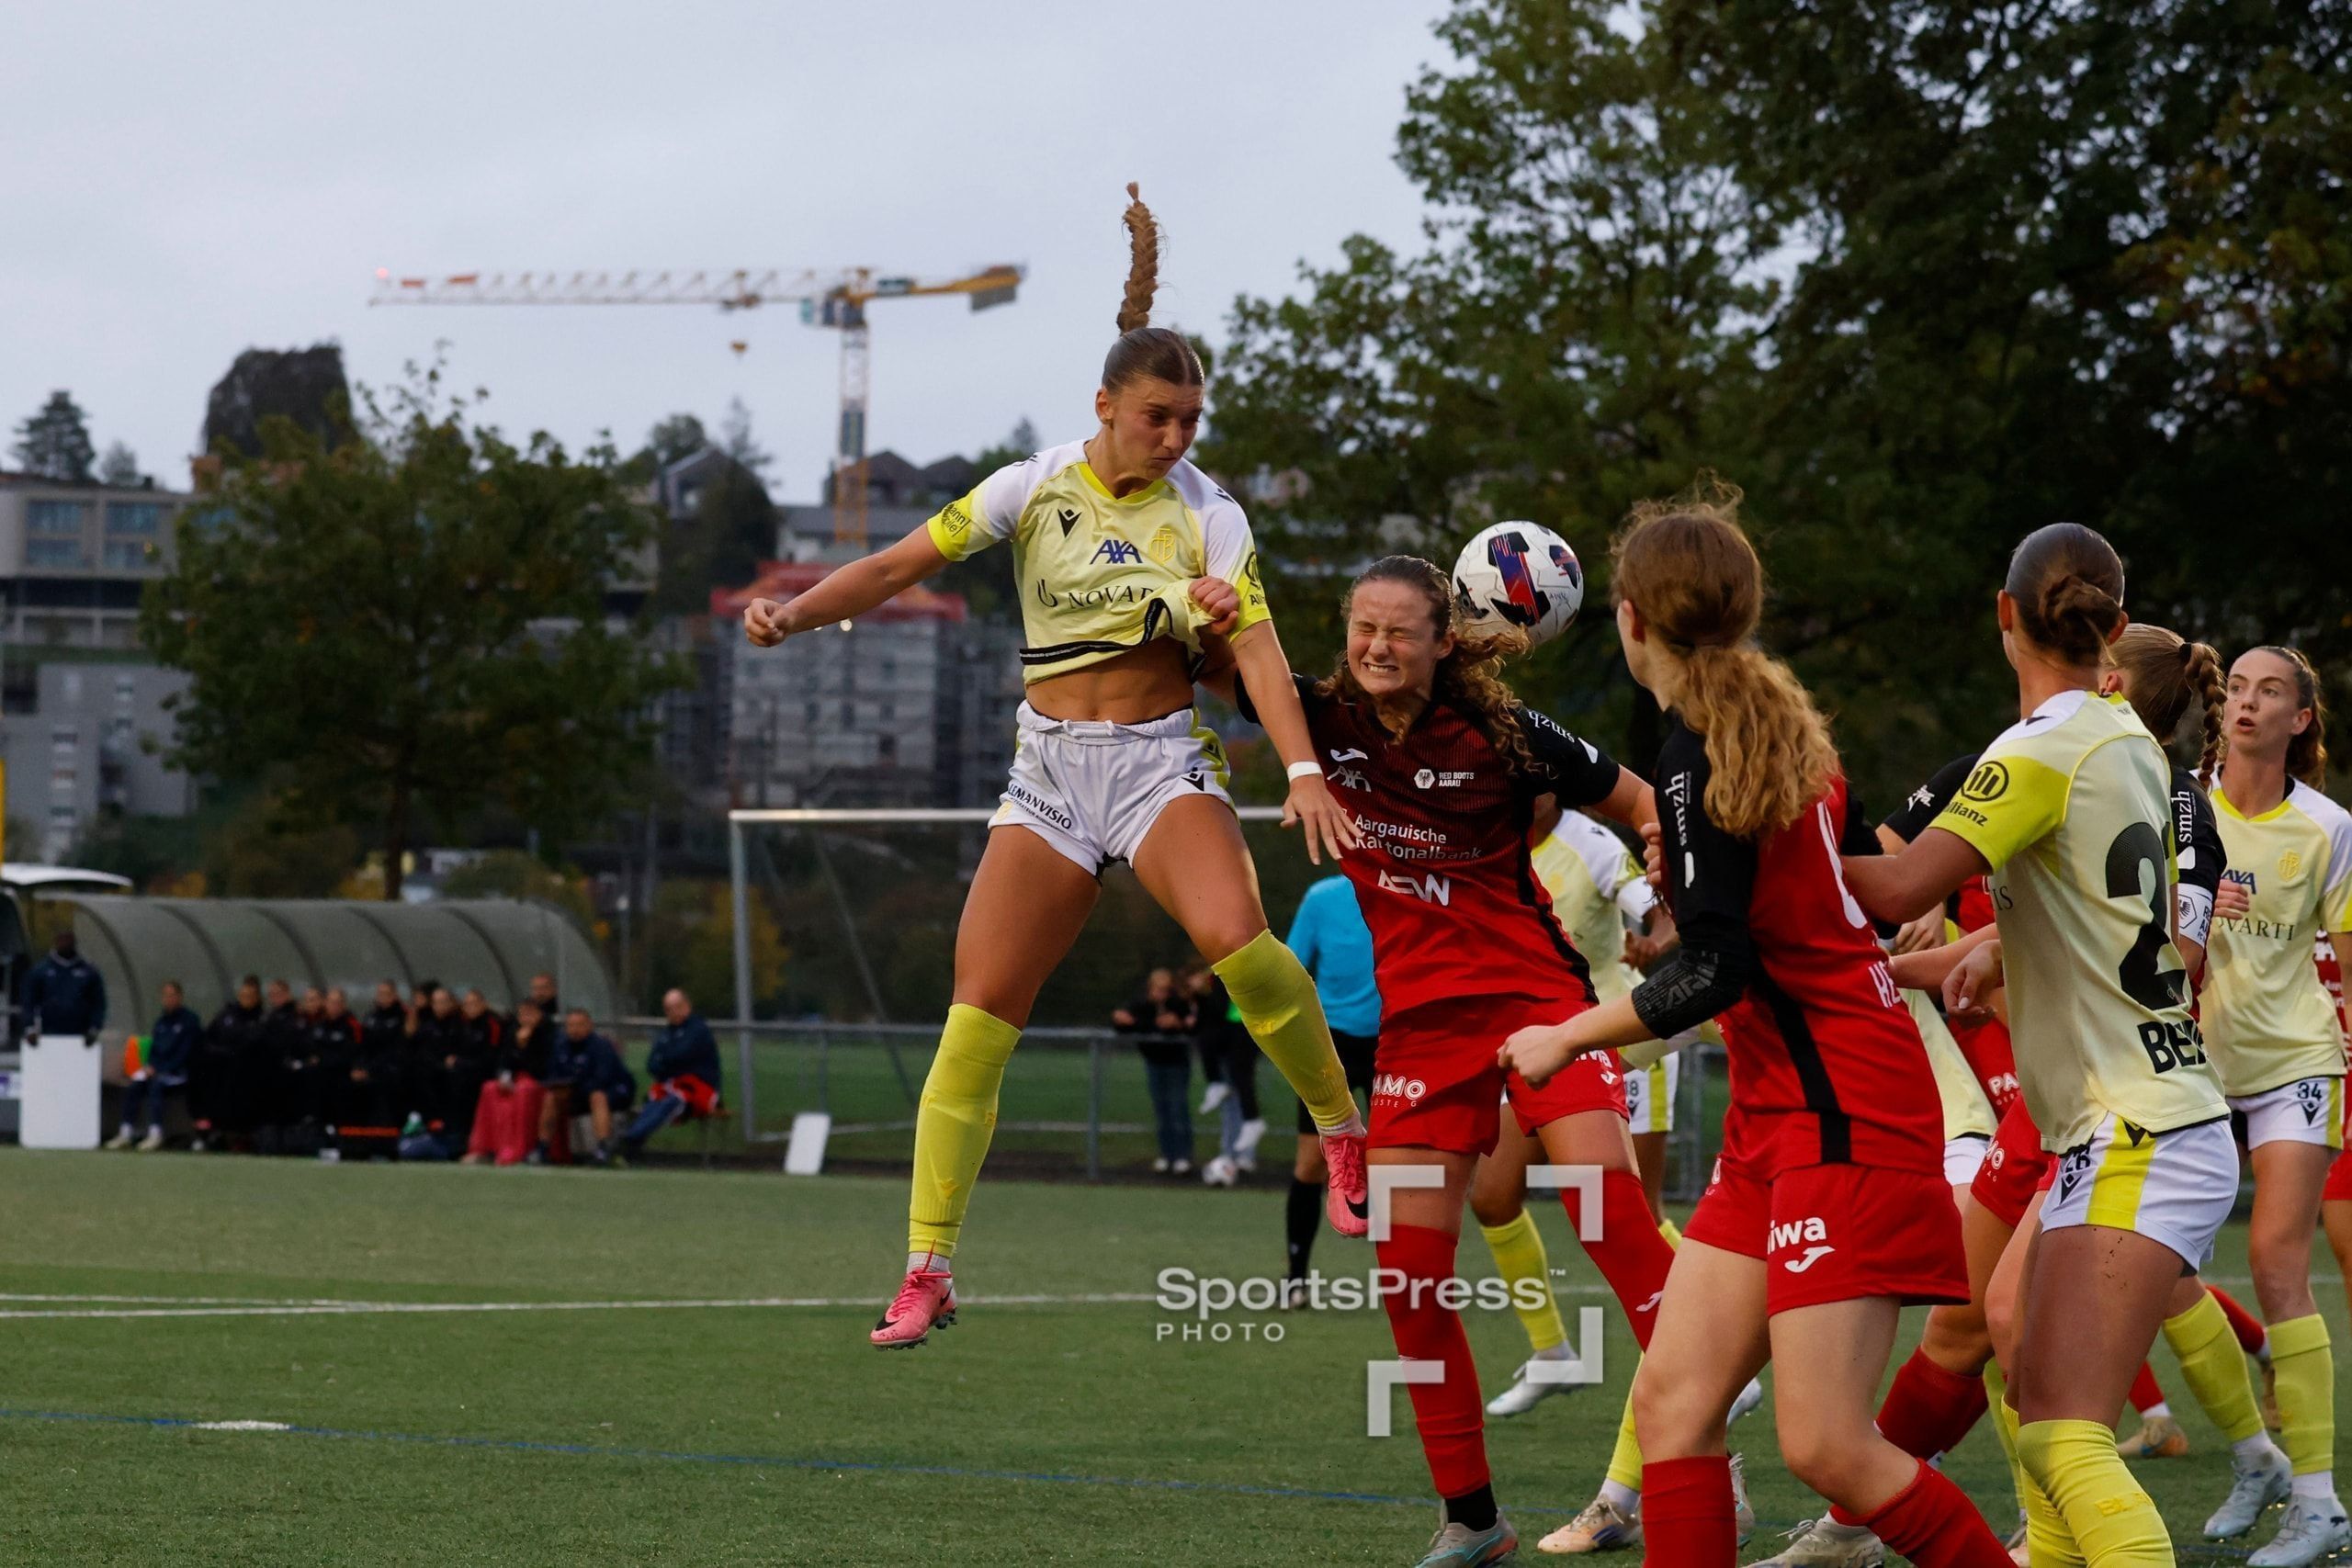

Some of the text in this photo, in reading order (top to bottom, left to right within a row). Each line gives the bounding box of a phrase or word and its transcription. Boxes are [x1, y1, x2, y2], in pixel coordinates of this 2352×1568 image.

[1090, 539, 1144, 565] AXA
[1438, 779, 1461, 787] AARAU
[1439, 772, 1475, 780] RED BOOTS
[1354, 814, 1447, 844] Aargauische
[2170, 790, 2193, 843] smzh
[2105, 821, 2188, 1010] 2
[2137, 1020, 2207, 1074] BE
[1987, 1072, 2020, 1097] PA
[2297, 1082, 2323, 1102] 34
[1767, 1216, 1827, 1256] iwa
